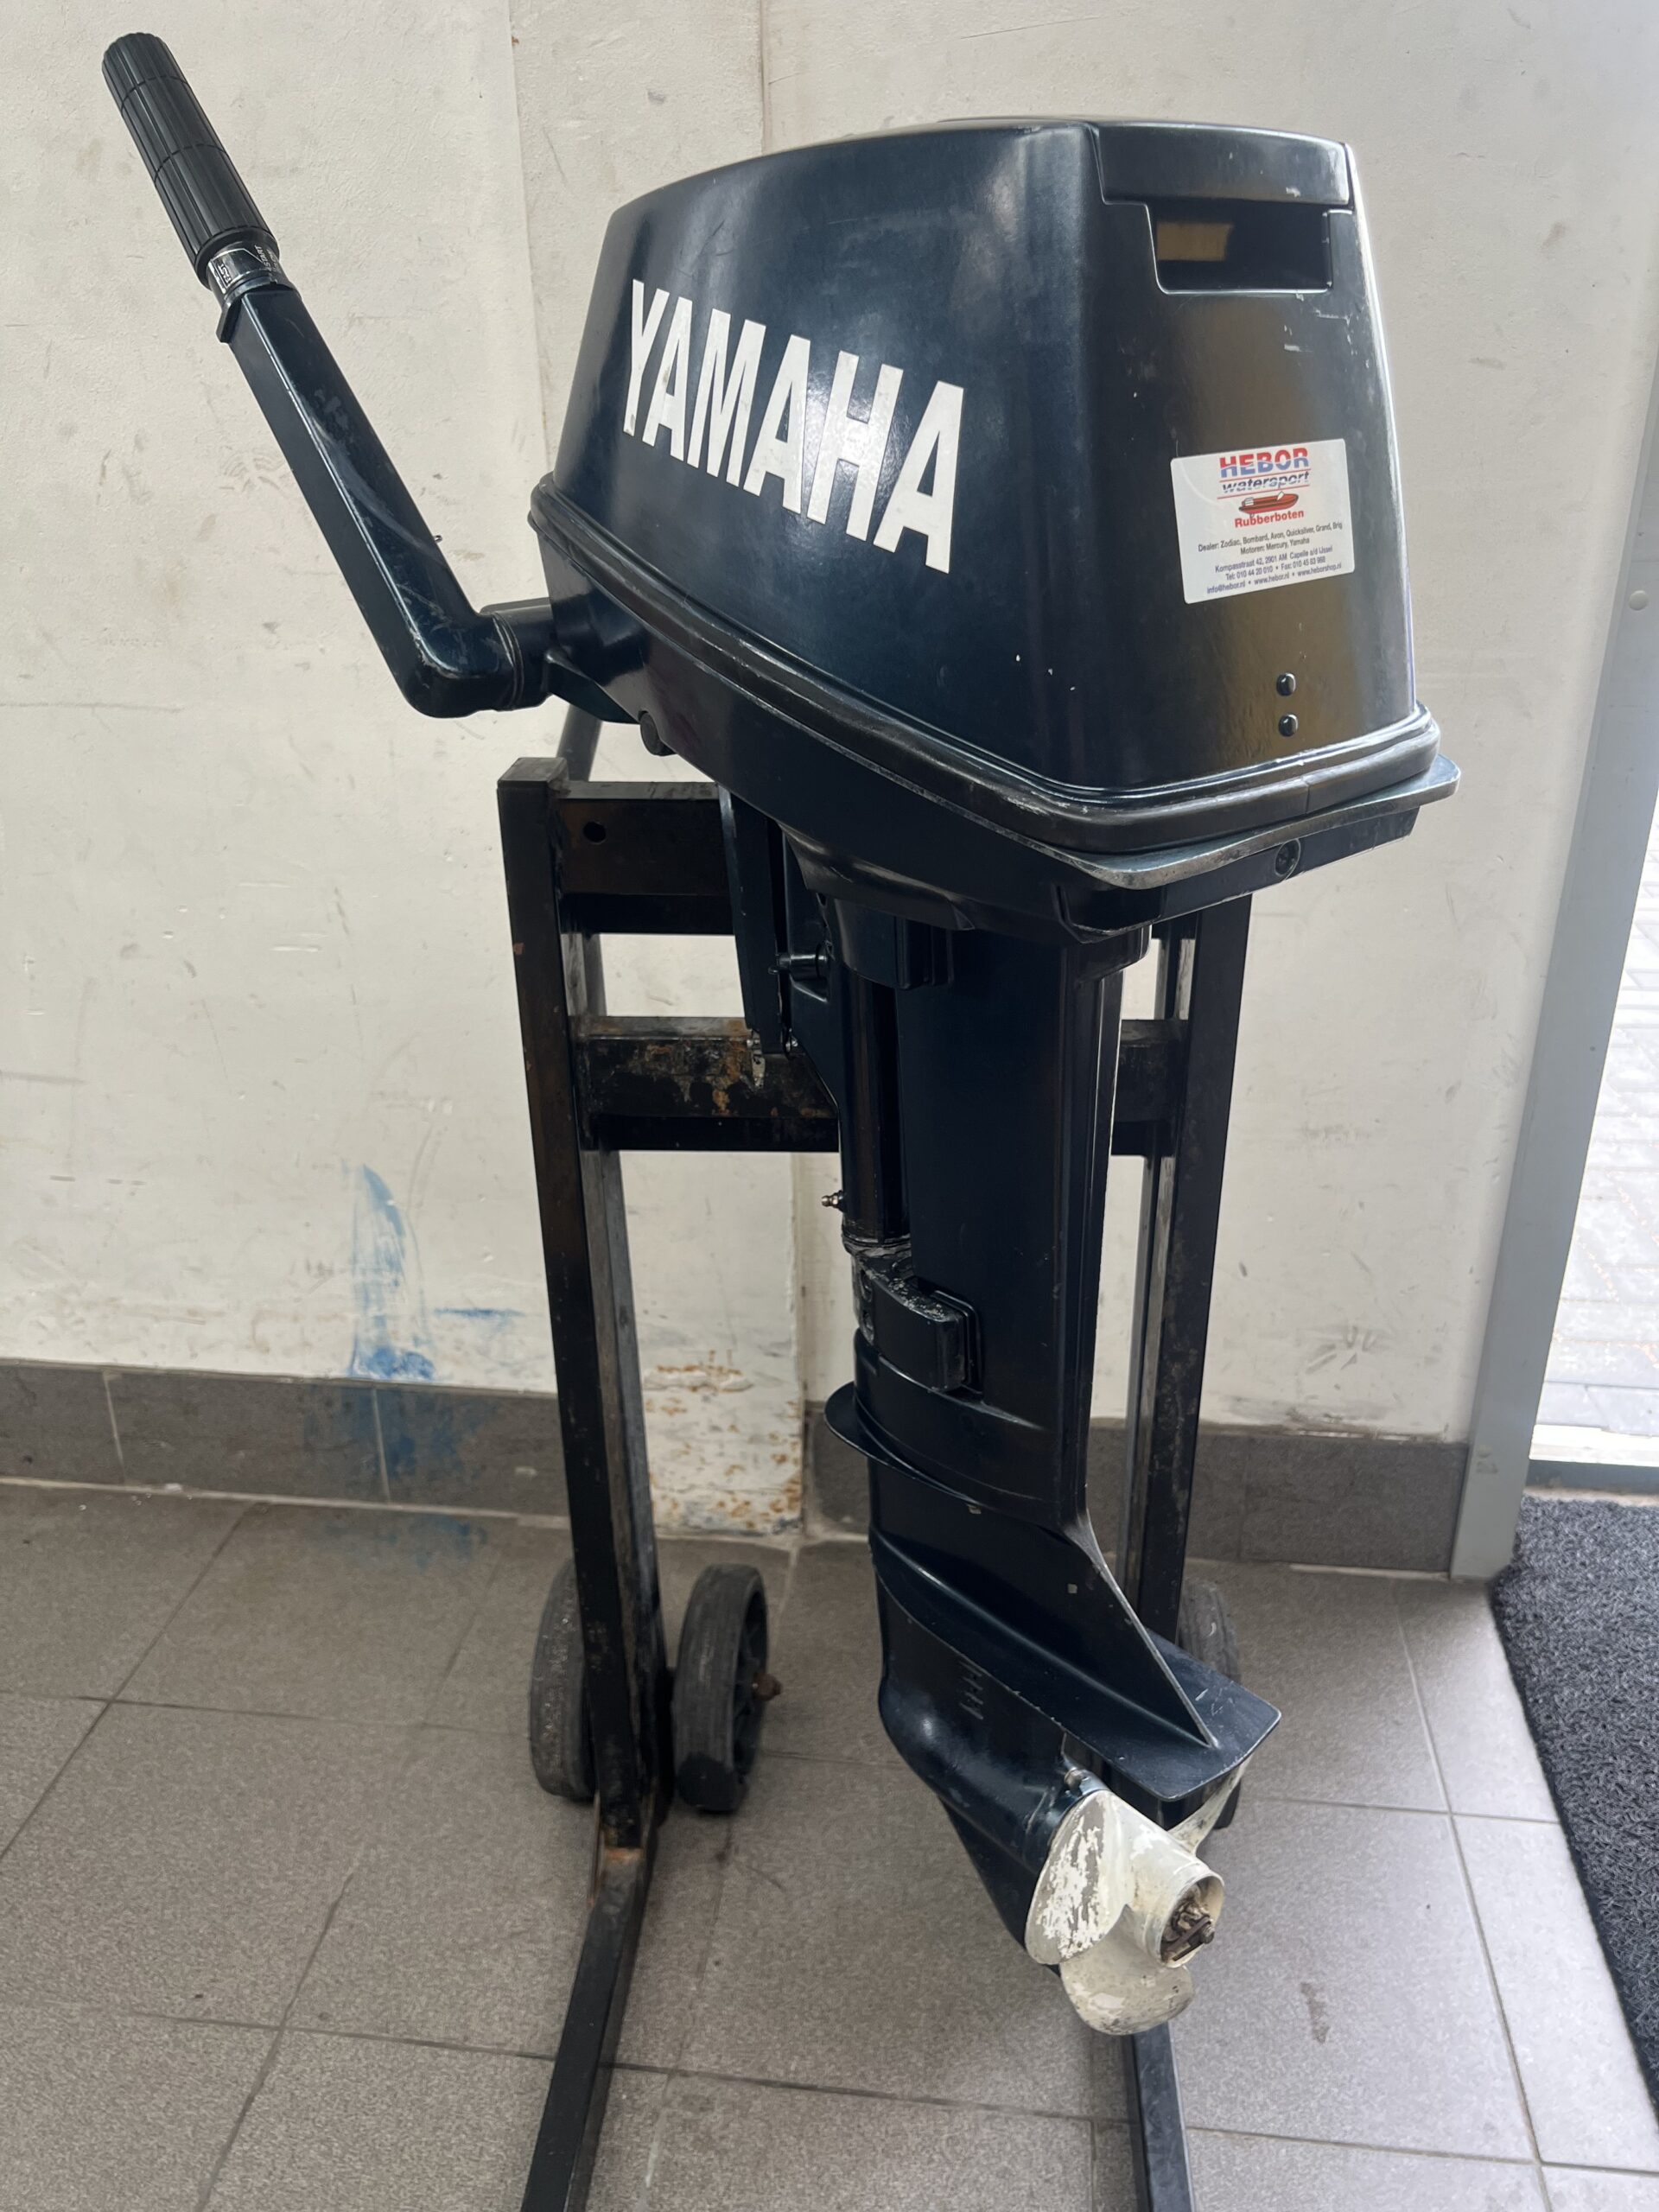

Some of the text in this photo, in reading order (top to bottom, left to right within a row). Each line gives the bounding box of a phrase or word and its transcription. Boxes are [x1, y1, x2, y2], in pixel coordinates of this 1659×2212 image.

[254, 245, 271, 269] START
[217, 263, 232, 285] FAST
[622, 278, 964, 574] YAMAHA
[1219, 448, 1309, 478] HEBOR
[1223, 471, 1309, 493] watersport
[1234, 511, 1304, 528] Rubberboten
[1198, 521, 1343, 552] Dealer: Zodiac, Bombard, Avon, Quicksilver, Grand, Brig
[1240, 537, 1310, 555] Motoren: Mercury, Yamaha
[1255, 557, 1264, 566] 42,
[1279, 553, 1287, 562] AM
[1206, 580, 1245, 594] info@hebor.nl
[1254, 572, 1290, 585] www.hebor.nl
[1236, 570, 1247, 579] 010
[1262, 565, 1274, 574] 010
